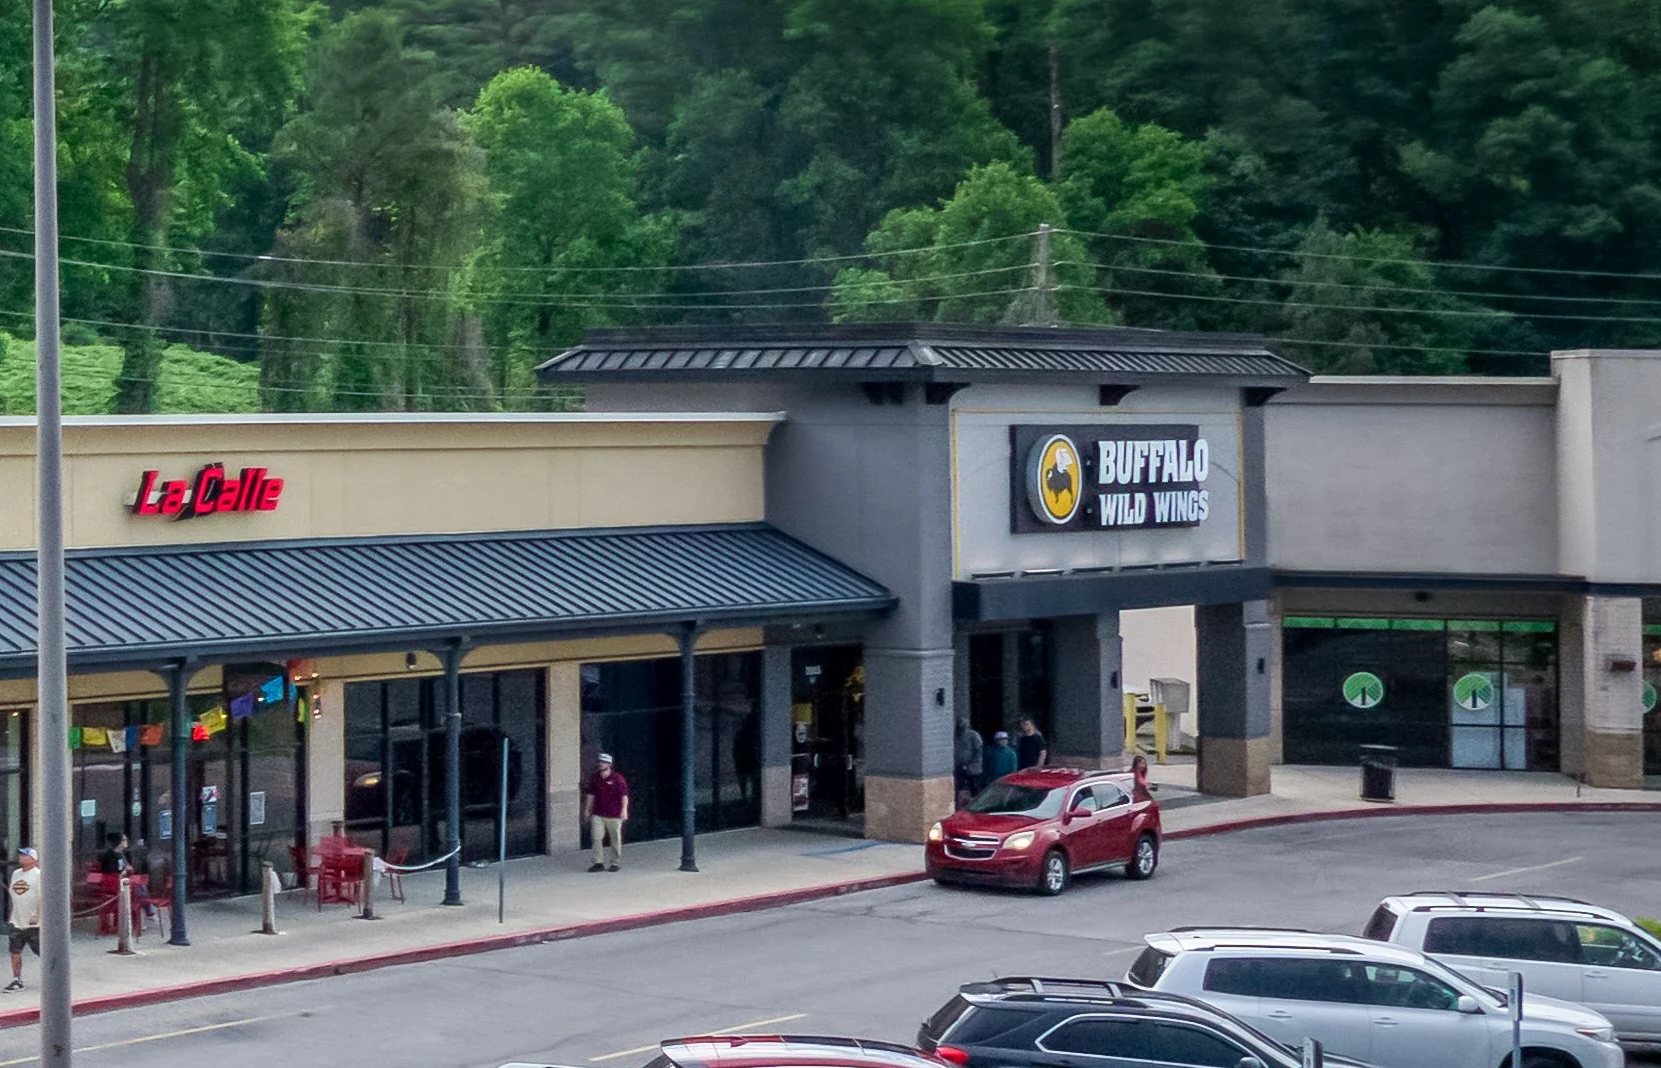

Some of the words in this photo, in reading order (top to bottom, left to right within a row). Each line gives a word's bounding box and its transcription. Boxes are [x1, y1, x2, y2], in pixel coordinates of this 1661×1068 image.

[1098, 438, 1209, 484] BUFFALO
[135, 470, 189, 514] La
[192, 463, 285, 516] Calle
[1098, 492, 1147, 526] WILD
[1153, 490, 1209, 523] WINGS
